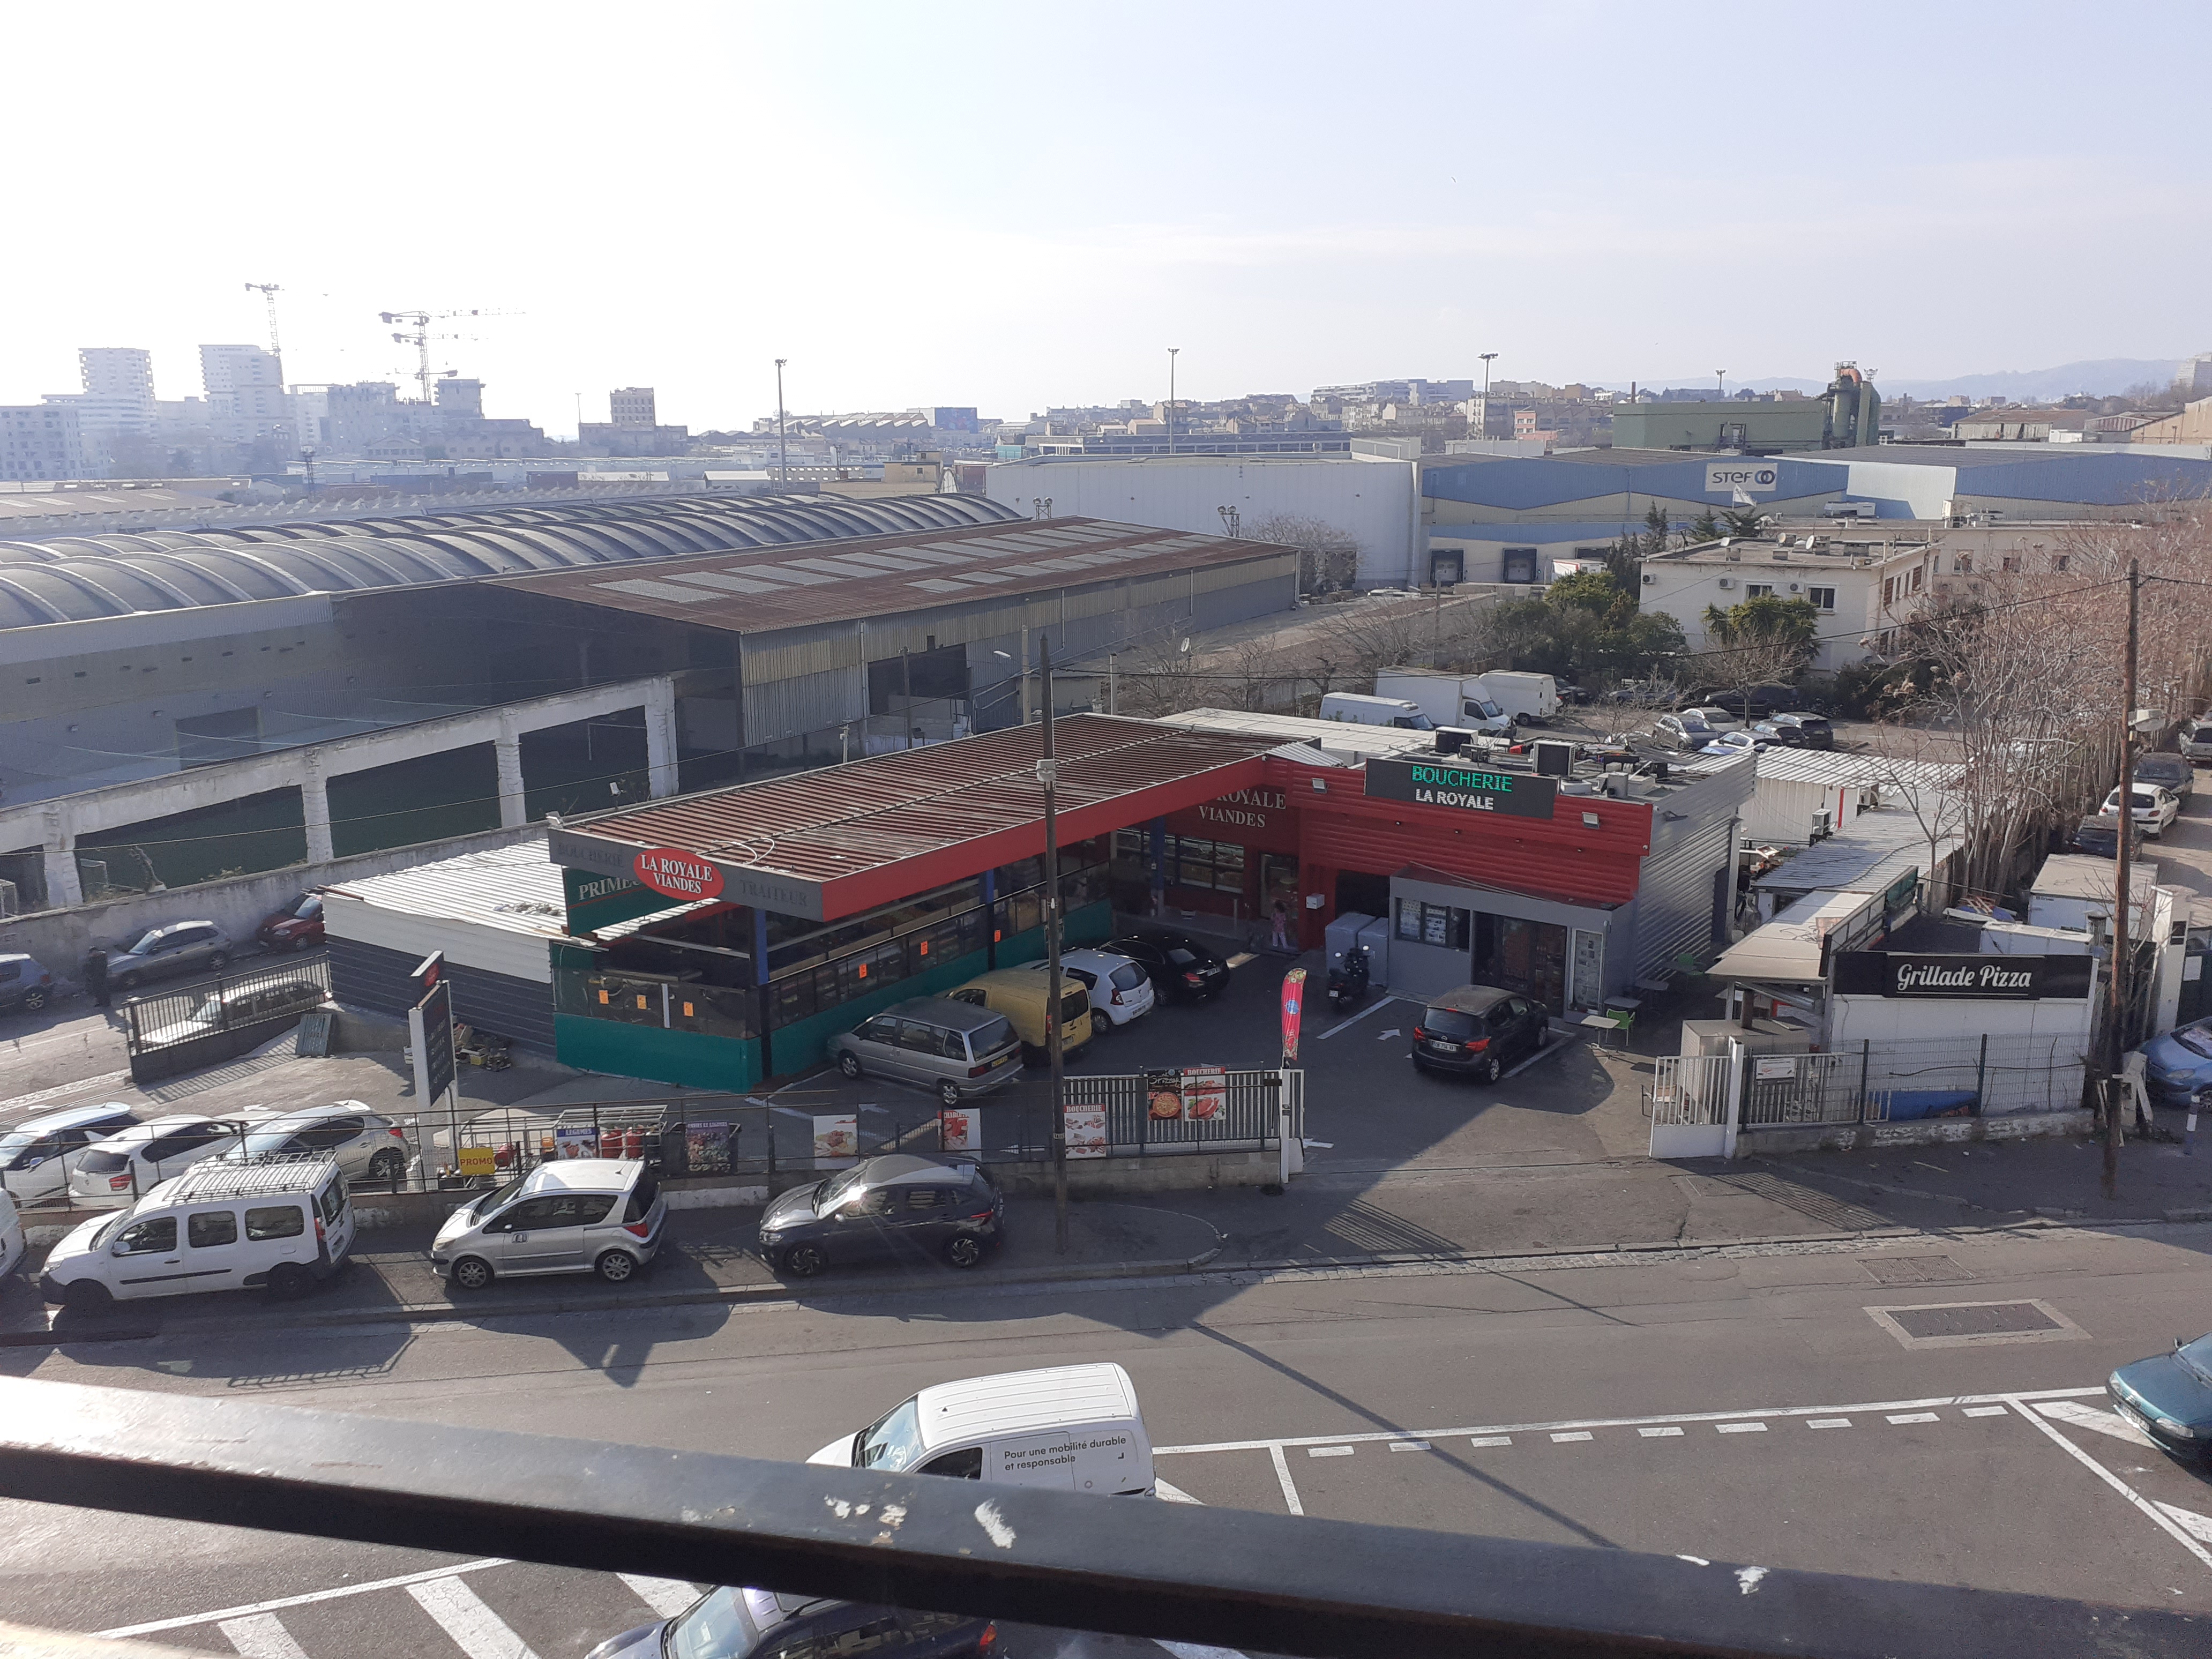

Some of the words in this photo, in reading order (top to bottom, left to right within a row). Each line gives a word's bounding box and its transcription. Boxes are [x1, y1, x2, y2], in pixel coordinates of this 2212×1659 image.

[1412, 765, 1513, 793] BOUCHERIE
[1416, 788, 1433, 802] LA
[1437, 791, 1494, 810] ROYALE
[1199, 805, 1266, 828] VIANDES
[641, 855, 659, 870] LA
[661, 857, 713, 882] ROYALE
[653, 872, 702, 894] VIANDES
[740, 879, 808, 907] TRAITEUR
[1897, 963, 1975, 991] Grillade
[1980, 965, 2032, 988] Pizza
[1066, 1104, 1102, 1112] BOUCHERIE
[460, 1157, 492, 1166] PROMO
[1004, 1450, 1026, 1459] Pour
[1049, 1440, 1087, 1454] mobilité
[1090, 1436, 1126, 1448] durable
[1017, 1454, 1076, 1469] responsable
